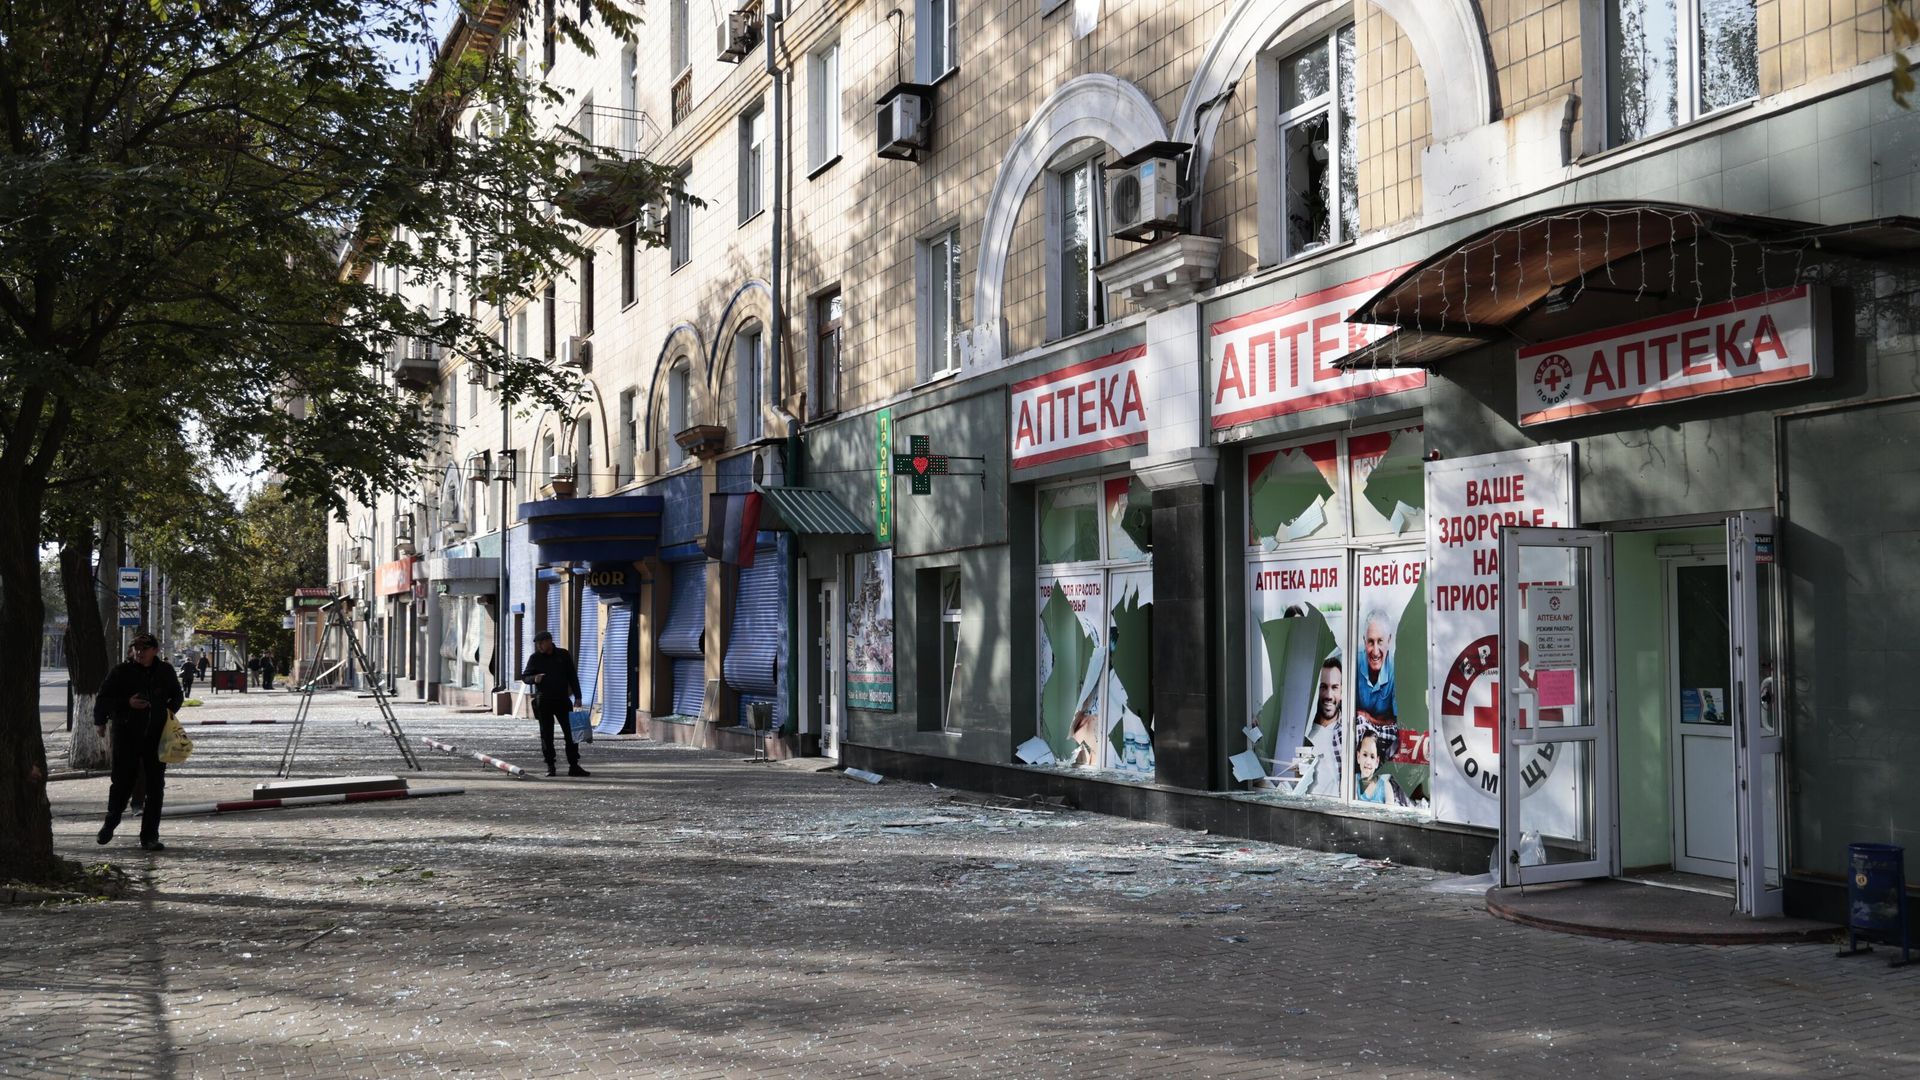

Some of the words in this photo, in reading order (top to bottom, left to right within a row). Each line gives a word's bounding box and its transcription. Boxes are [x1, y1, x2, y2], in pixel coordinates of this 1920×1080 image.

[1215, 307, 1397, 404] АПТЕК
[1584, 314, 1788, 395] АПТЕКА
[1014, 369, 1146, 451] АПТЕКА
[880, 417, 888, 537] ПРОДУКТЫ
[1466, 474, 1525, 507] ВАШЕ
[1255, 569, 1306, 591] АПТЕКА
[1309, 567, 1338, 593] ДЛЯ
[1363, 560, 1399, 587] ВСЕЙ
[1403, 562, 1426, 584] СЕ
[1473, 549, 1499, 576] НА
[1075, 583, 1102, 596] КРАСОТЫ
[1450, 734, 1555, 794] ПОМЩЬ
